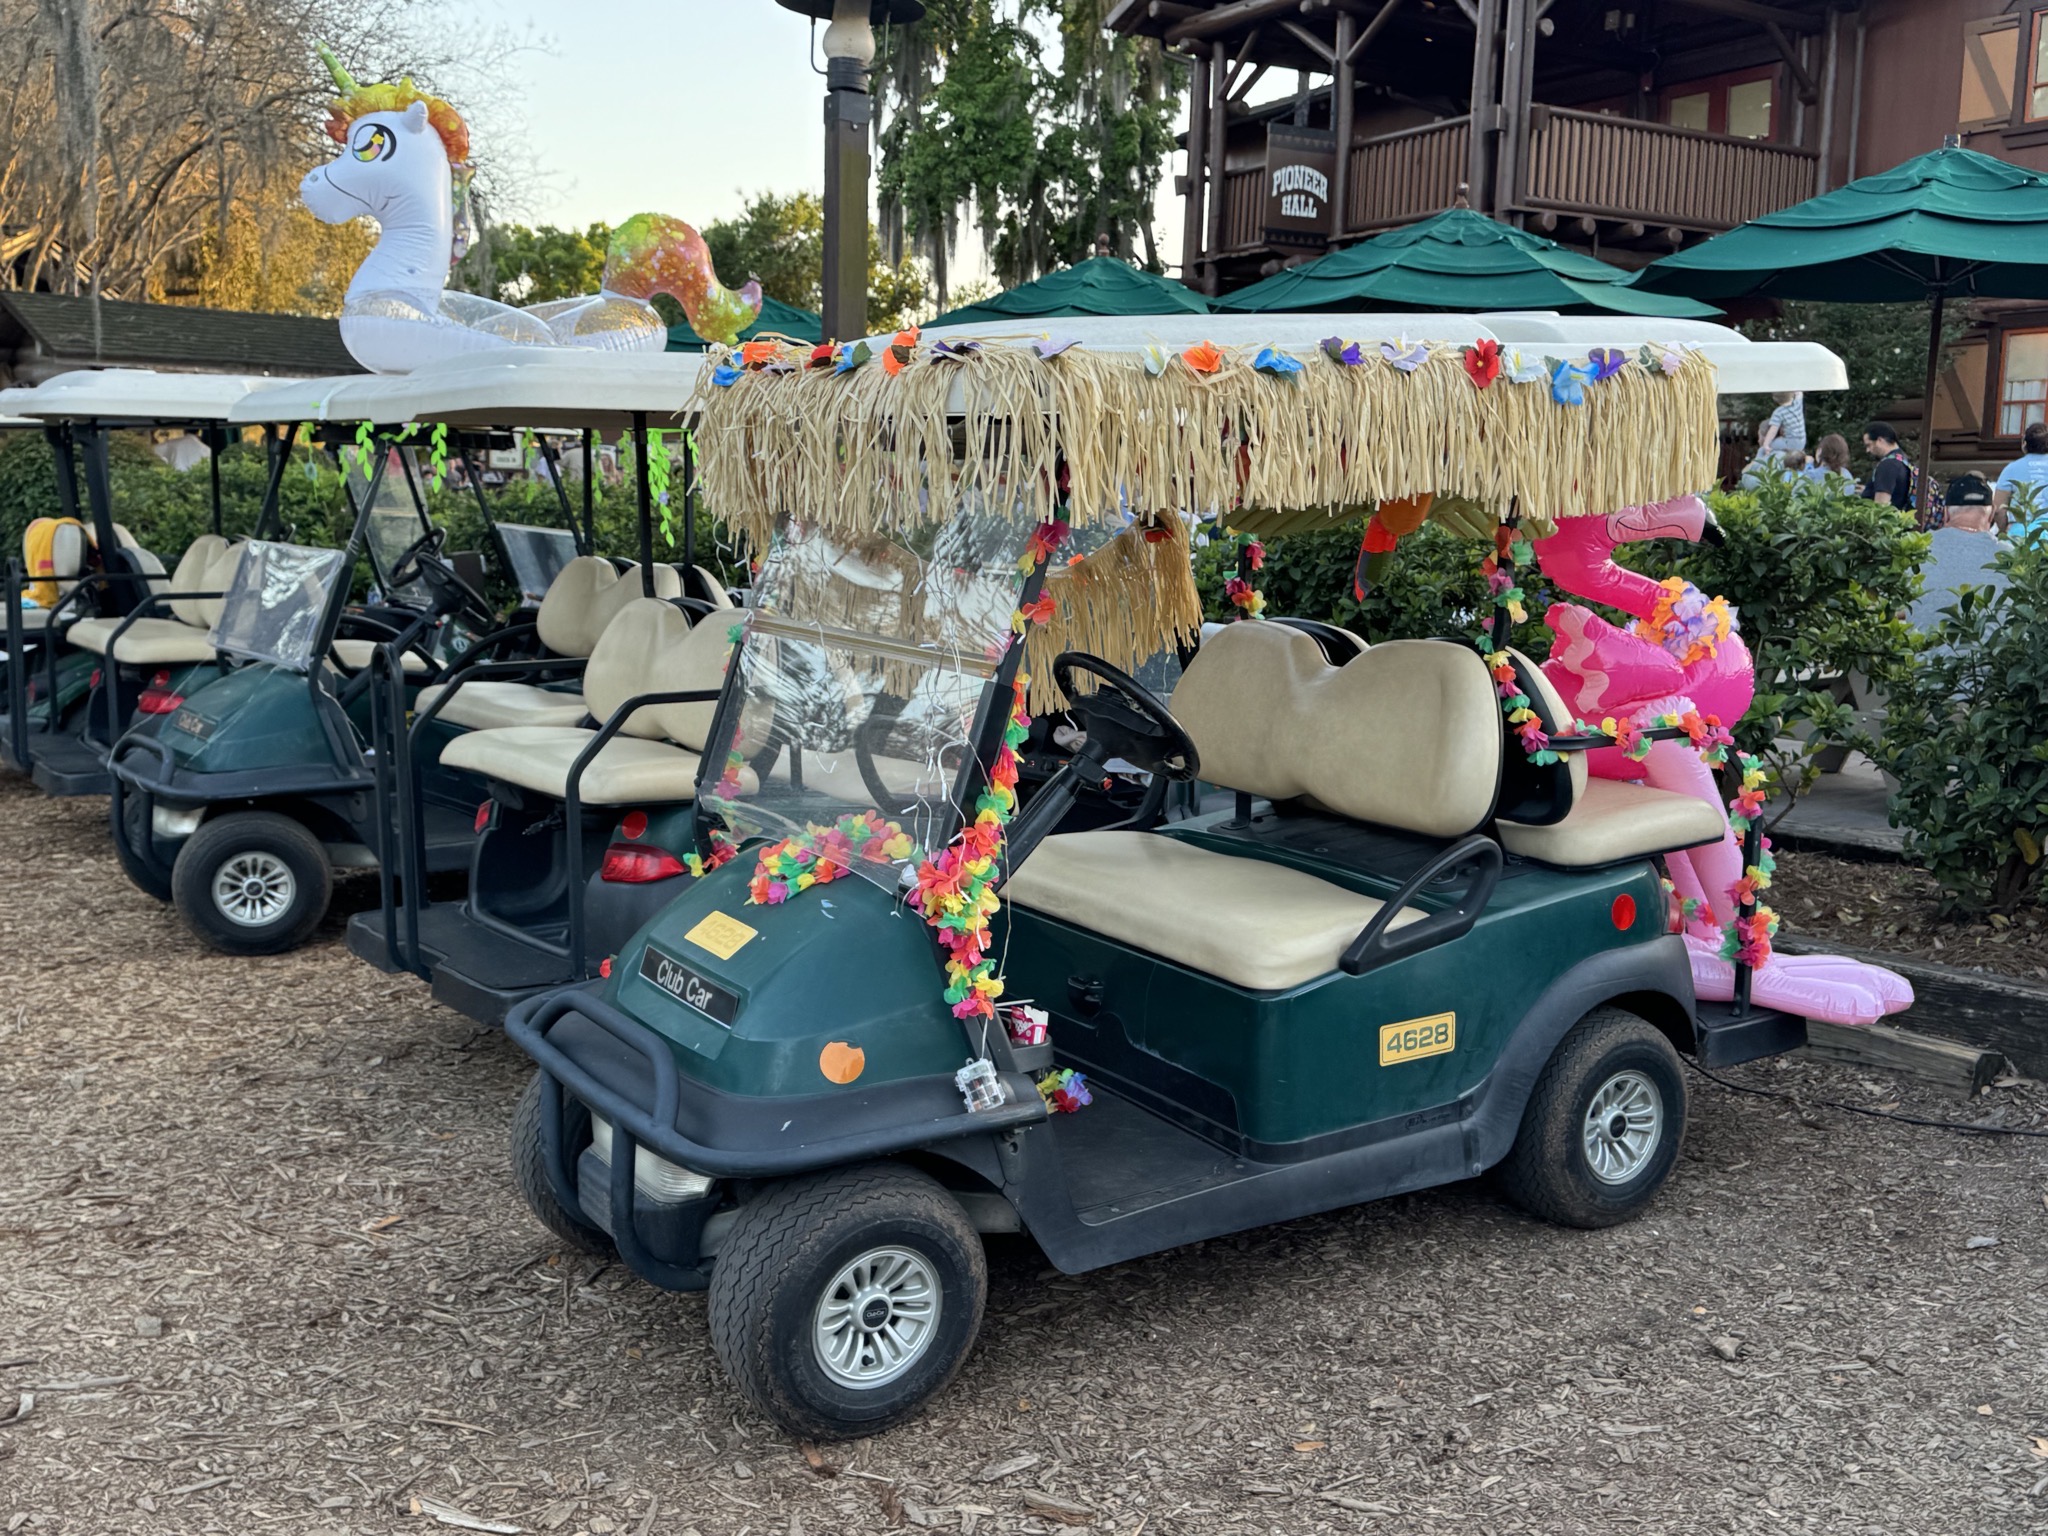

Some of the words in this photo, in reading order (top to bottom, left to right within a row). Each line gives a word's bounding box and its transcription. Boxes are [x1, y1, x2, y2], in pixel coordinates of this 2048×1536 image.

[1272, 165, 1328, 203] PIONEER
[1281, 194, 1317, 218] HALL
[701, 920, 746, 951] 4628
[656, 959, 685, 995] Club
[685, 977, 713, 1010] Car
[1386, 1022, 1449, 1053] 4628
